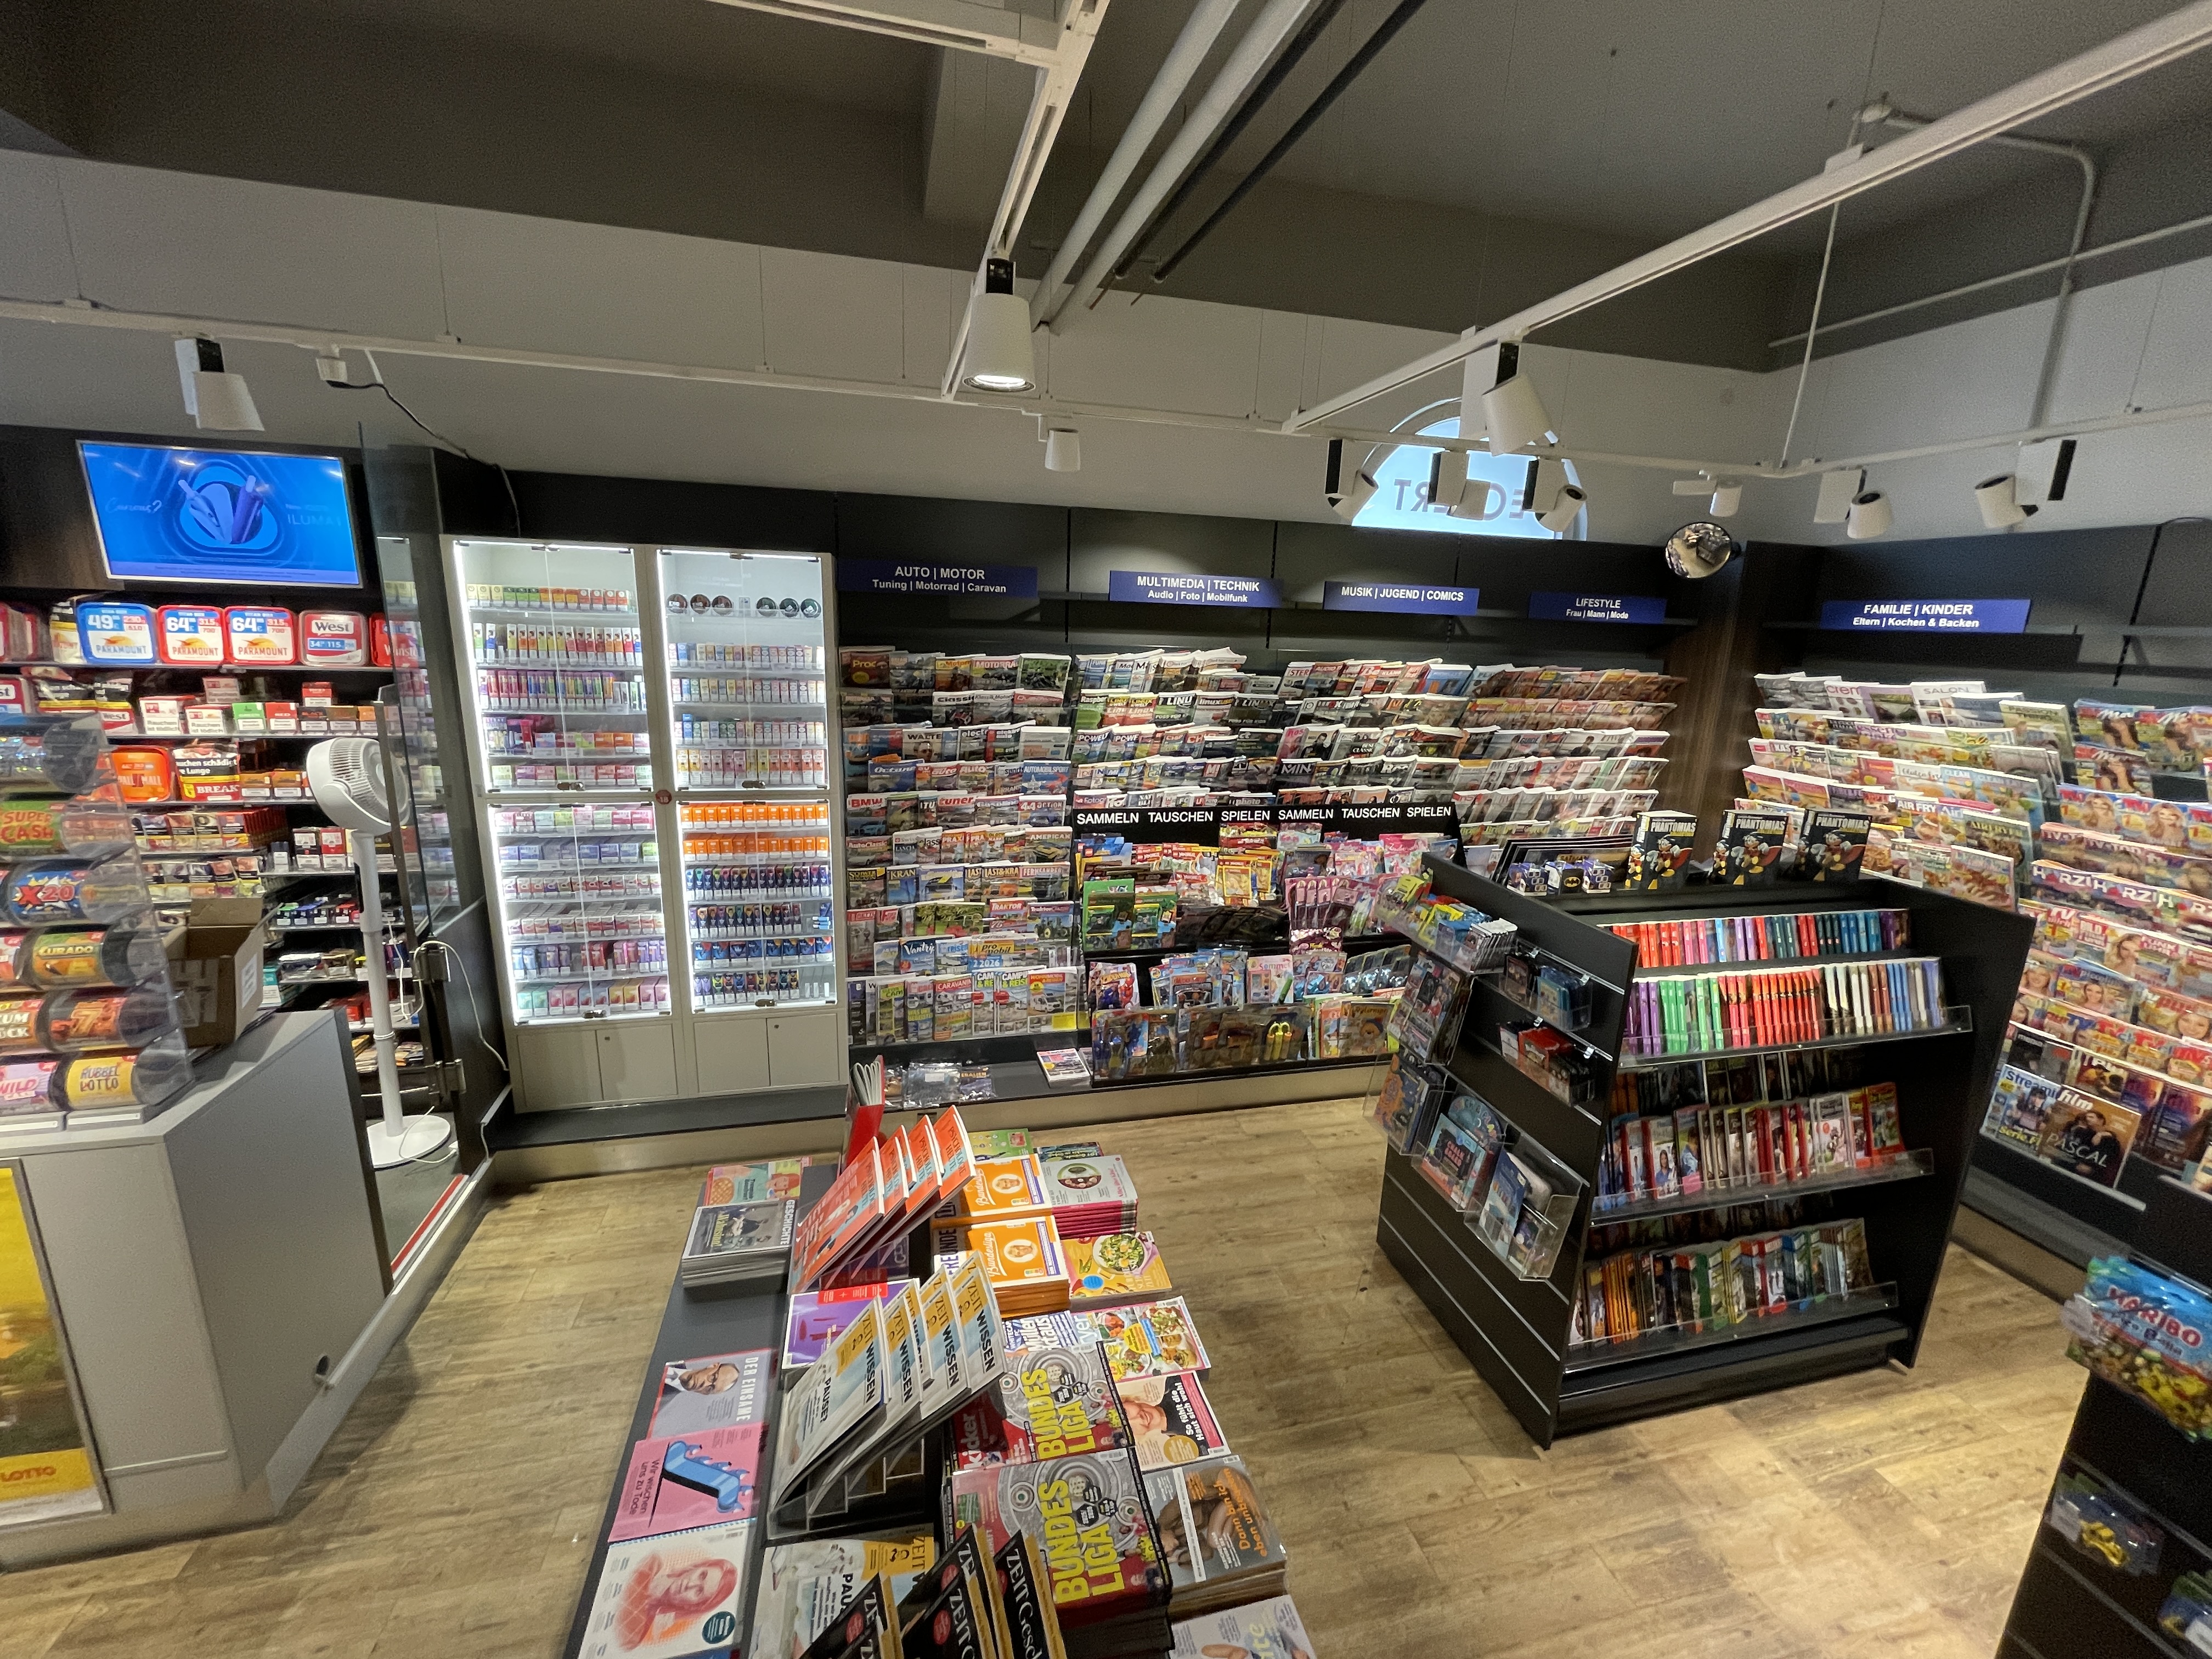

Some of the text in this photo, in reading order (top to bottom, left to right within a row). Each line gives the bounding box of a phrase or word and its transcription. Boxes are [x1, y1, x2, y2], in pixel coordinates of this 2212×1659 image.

[895, 567, 985, 580] AUTO MOTOR
[872, 579, 1006, 593] Tuning Motorrad Caravan
[1137, 575, 1260, 592] MULTIMEDIA TECHNIK
[1147, 590, 1248, 603] Audio Foto Mobilfunk
[1341, 586, 1464, 601] MUSIK JUGEND COMICS
[1576, 597, 1621, 608] LIFESTYLE
[1566, 609, 1581, 618] Frau
[1587, 610, 1605, 619] Mann
[1864, 603, 1973, 616] FAMILIE KINDER
[315, 622, 349, 632] West
[1853, 617, 1979, 628] Eltern Kochen & Backen
[95, 645, 147, 655] PARAMOUNT
[172, 646, 219, 656] PARAMOUNT
[238, 646, 287, 656] PARAMOUNT
[1923, 686, 1969, 695] SALON
[196, 785, 239, 794] BREAK
[850, 798, 883, 808] BMW
[3, 811, 54, 825] SUPER
[1076, 806, 1452, 825] SAMMELN TAUSCHEN SPIELEN SAMMELN TAUSCHEN SPIELEN
[1735, 819, 1786, 831] PHANTOMIAS
[1816, 816, 1870, 830] PHANTOMIAS
[0, 824, 54, 842] CASH
[1650, 822, 1696, 833] PHANTOMIAS
[991, 902, 1022, 911] TRAKTOR
[81, 1065, 120, 1080] RUBBEL
[2057, 1089, 2094, 1112] film
[2045, 1132, 2107, 1168] PASCAL
[779, 1199, 795, 1245] GESCHICHTE
[2107, 1285, 2204, 1348] HARIBO
[966, 1280, 996, 1373] ZEIT WISSEN
[1019, 1318, 1045, 1352] Müller
[934, 1296, 961, 1388] ZEIT WISSEN
[862, 1316, 876, 1404] ZEIT WISSEN
[899, 1342, 913, 1403] WISSEN
[735, 1356, 760, 1422] DER EINSAME
[819, 1377, 833, 1423] PAUSE?
[1020, 1369, 1067, 1460] BUNDES
[1170, 1389, 1195, 1436] So fühlt die
[1174, 1381, 1206, 1441] Haut sich wohl
[1057, 1400, 1096, 1454] LIGA
[959, 1413, 983, 1470] kicker
[1, 1465, 56, 1482] LOTTO
[629, 1462, 649, 1515] uns zu Tode
[639, 1459, 660, 1515] Wir wischen
[1214, 1479, 1251, 1550] Dann bin ich
[1037, 1479, 1087, 1604] BUNDES
[1250, 1526, 1268, 1558] eben
[1080, 1522, 1125, 1596] LIGA
[1005, 1548, 1032, 1602] ZEIT
[948, 1588, 971, 1643] ZEIT
